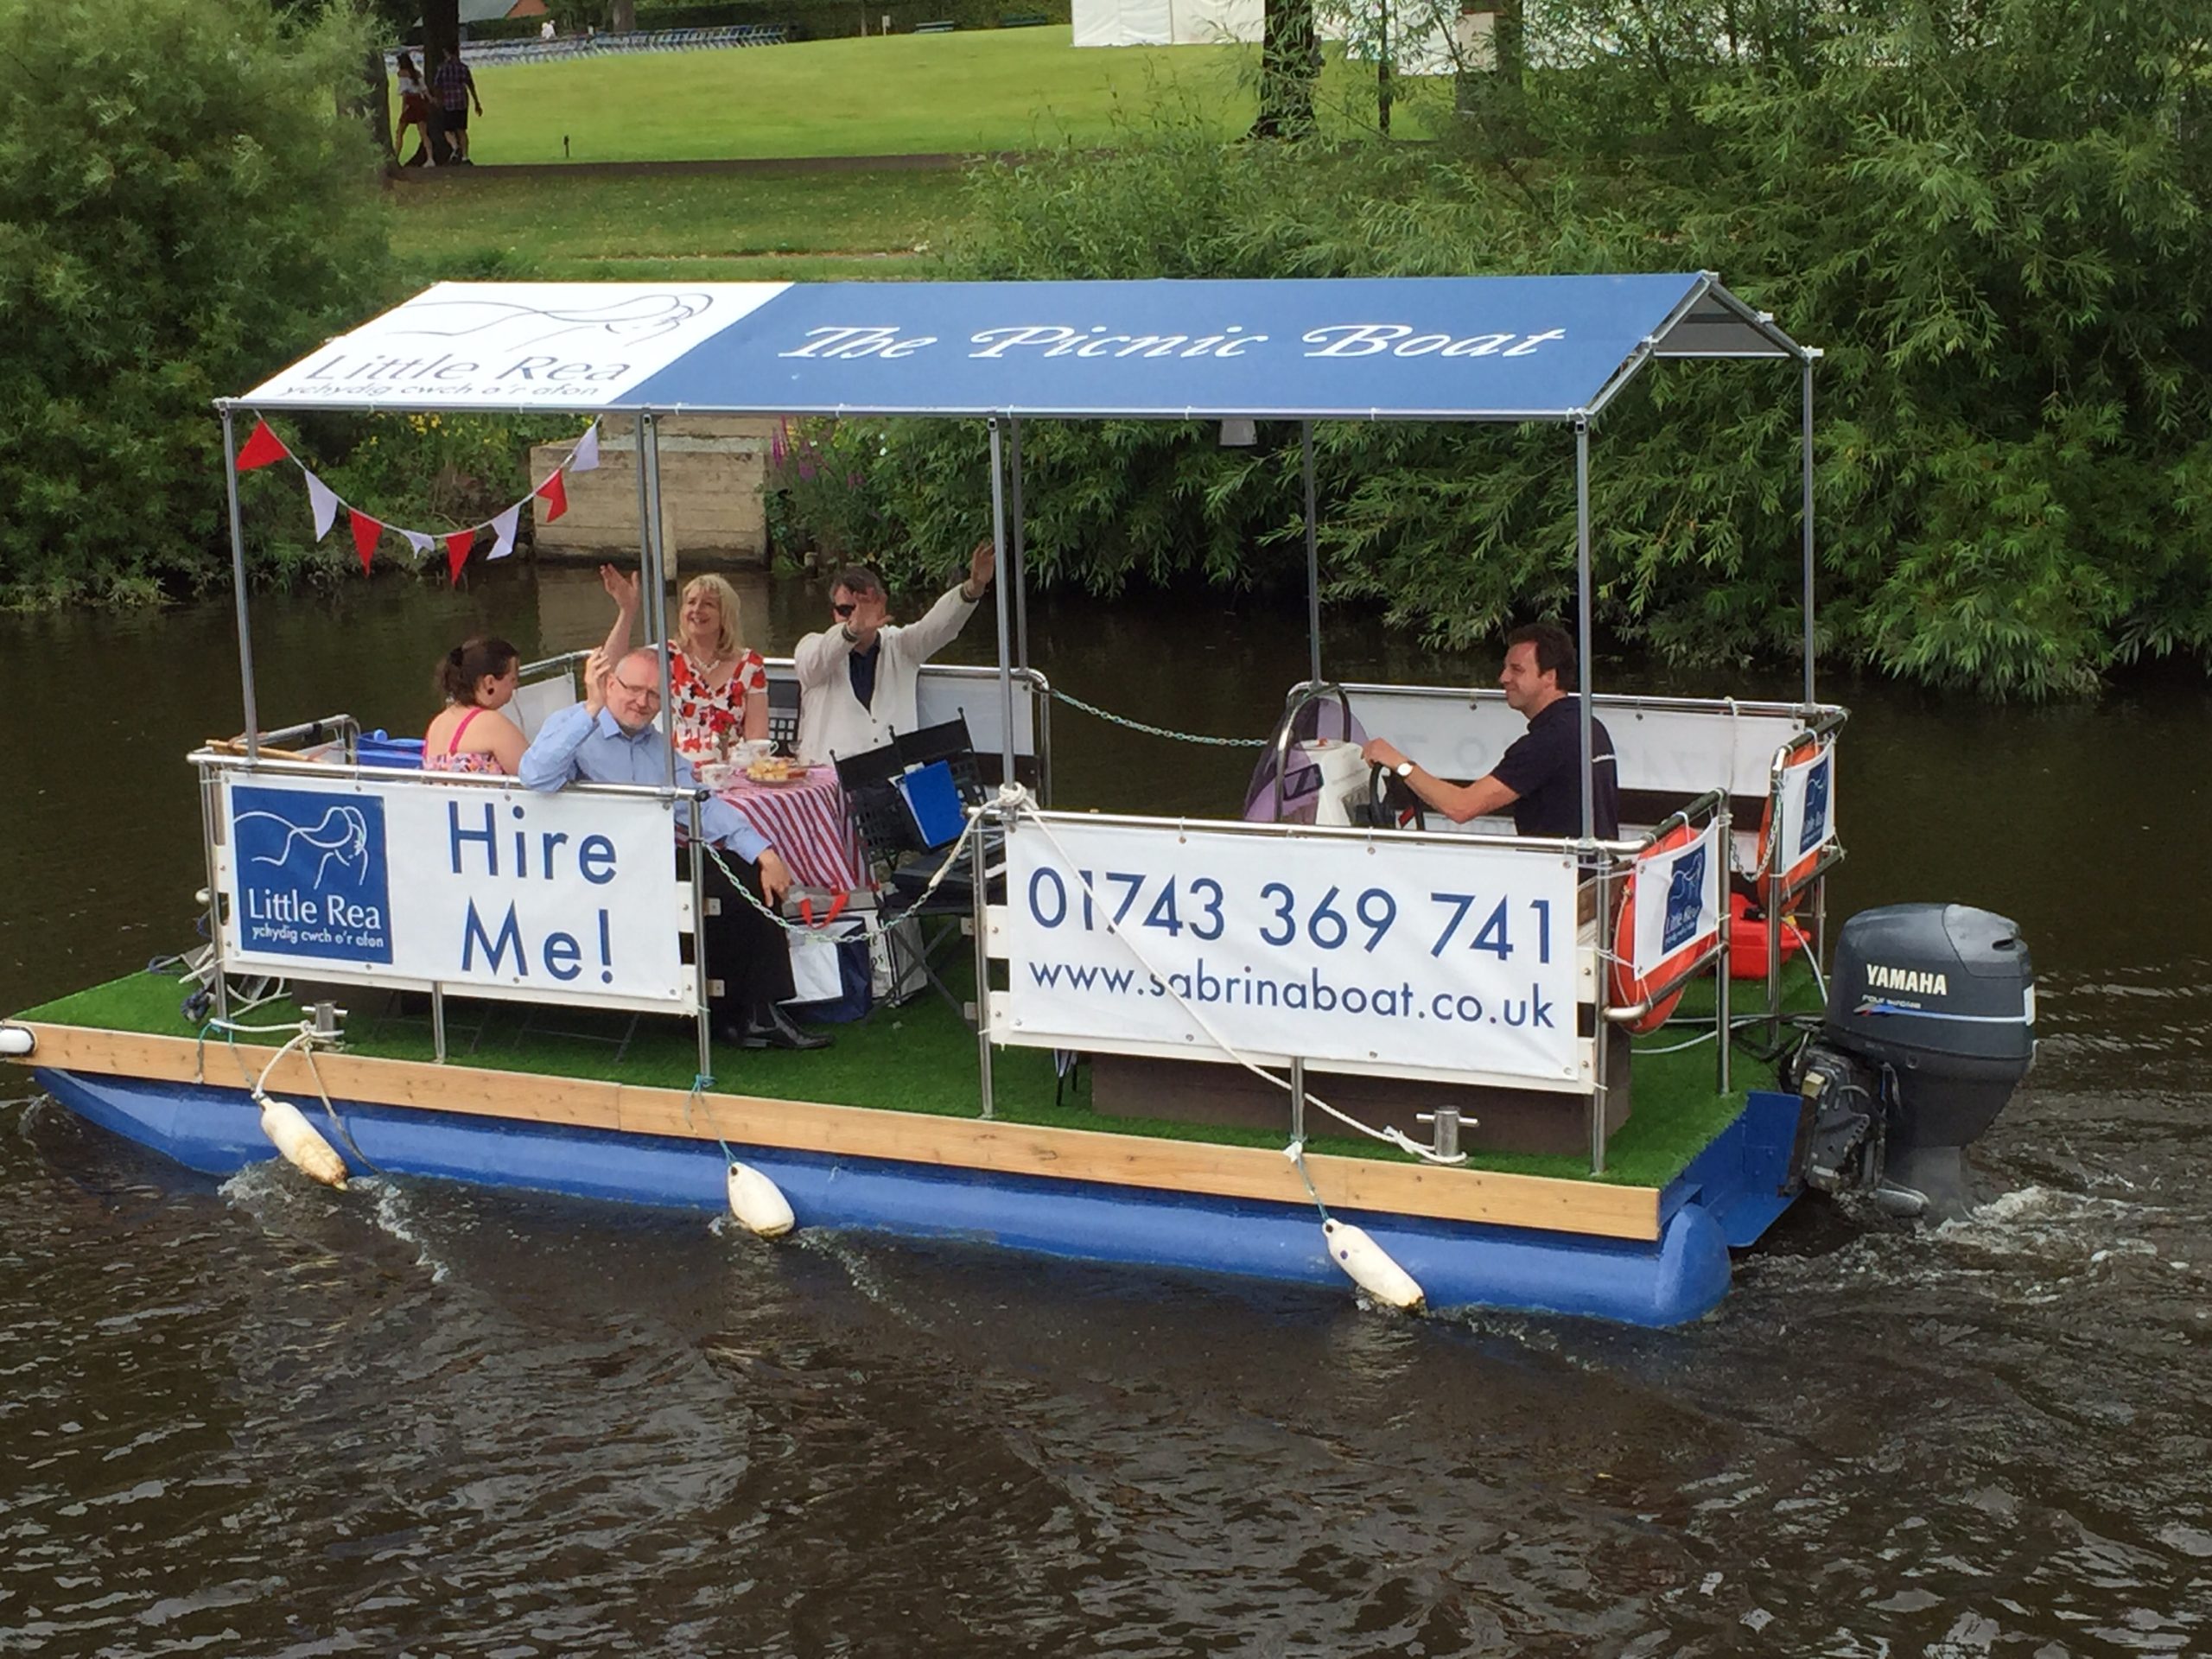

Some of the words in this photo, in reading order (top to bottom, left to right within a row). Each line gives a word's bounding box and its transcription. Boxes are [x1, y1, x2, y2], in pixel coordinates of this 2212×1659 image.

[304, 353, 480, 380] Little
[494, 355, 631, 381] Rea
[778, 327, 938, 360] The
[968, 325, 1268, 359] Picnic
[1301, 324, 1567, 359] Boat
[448, 800, 617, 885] Hire
[248, 888, 318, 924] Little
[327, 894, 381, 930] Rea
[1028, 866, 1225, 941] 01743
[1259, 881, 1397, 953] 369
[1430, 892, 1550, 964] 741
[461, 895, 613, 984] Me!
[1028, 958, 1555, 1029] www.sabrinaboat.co.uk
[1866, 963, 1947, 995] YAMAHA
